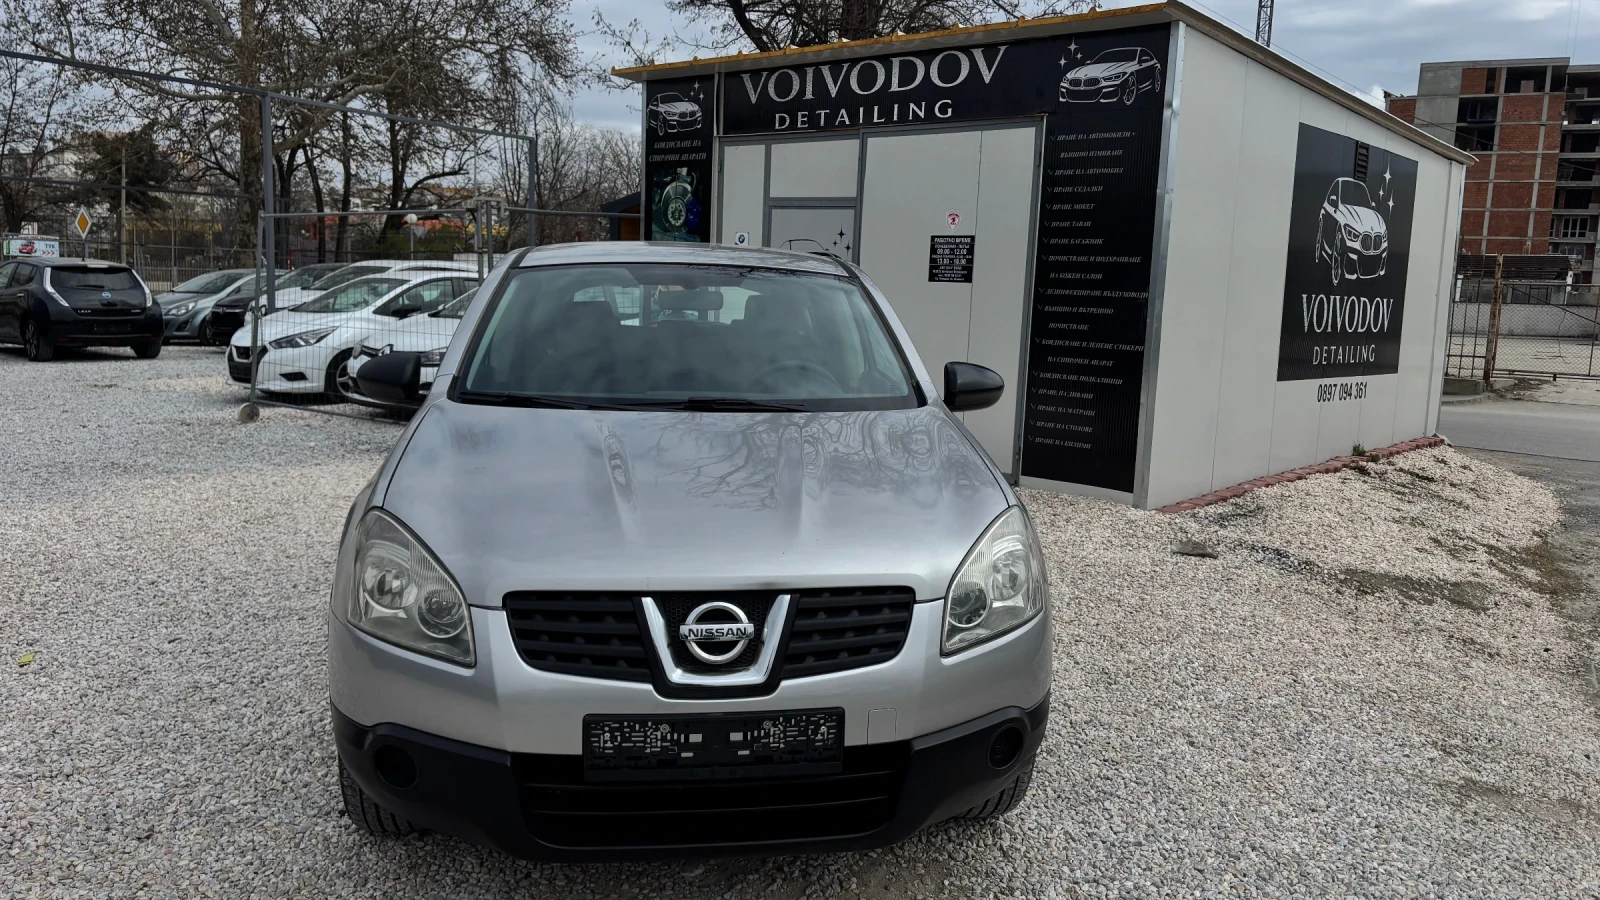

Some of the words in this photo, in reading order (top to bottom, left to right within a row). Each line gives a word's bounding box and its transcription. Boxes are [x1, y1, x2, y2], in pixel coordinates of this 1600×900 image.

[740, 45, 1009, 104] VOIVODOV
[775, 100, 954, 129] DETAILING
[654, 140, 692, 148] БОЯДИСВАНЕ
[1302, 294, 1394, 333] VOIVODOV
[1313, 344, 1375, 364] DETAILING
[1317, 384, 1337, 402] 0897
[1339, 383, 1352, 401] 094
[1354, 381, 1368, 399] 361
[1066, 408, 1095, 416] МАТРАЦИ
[1066, 424, 1093, 432] СТОЛОВЕ
[688, 627, 746, 638] NISSAN
